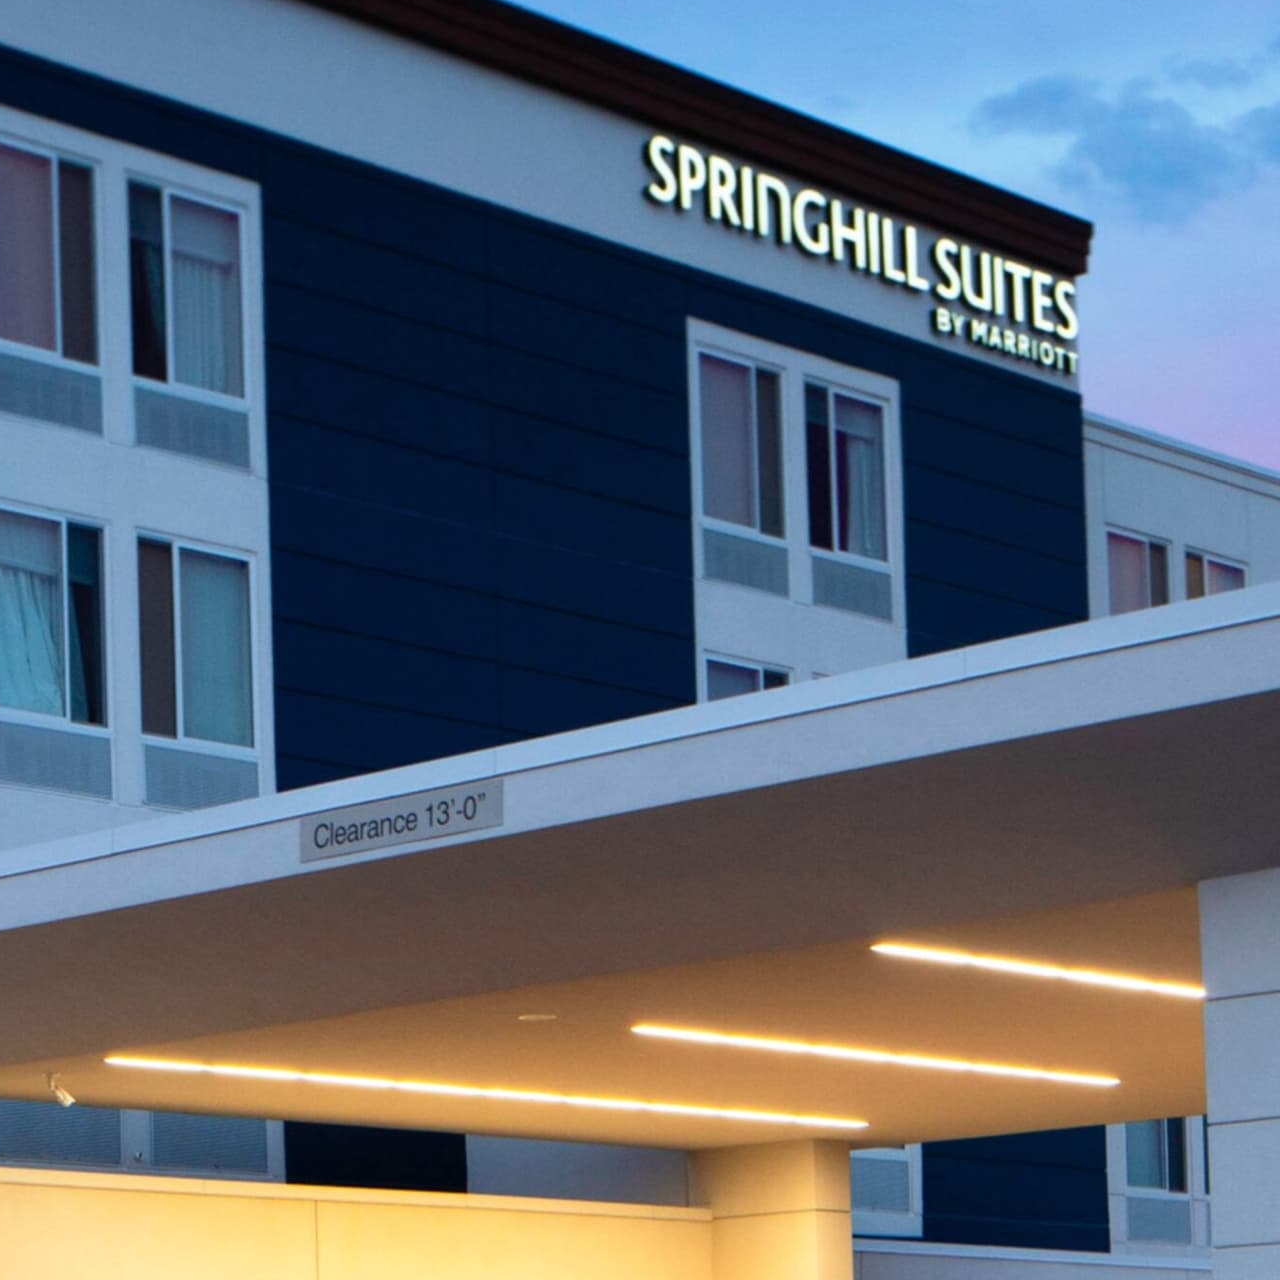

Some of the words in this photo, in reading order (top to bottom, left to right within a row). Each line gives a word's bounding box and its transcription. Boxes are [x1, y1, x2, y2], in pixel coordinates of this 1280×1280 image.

[648, 135, 930, 291] SPRINGHILL
[935, 238, 1080, 340] SUITES
[935, 307, 965, 336] BY
[971, 319, 1078, 373] MARRIOTT
[313, 812, 418, 849] Clearance
